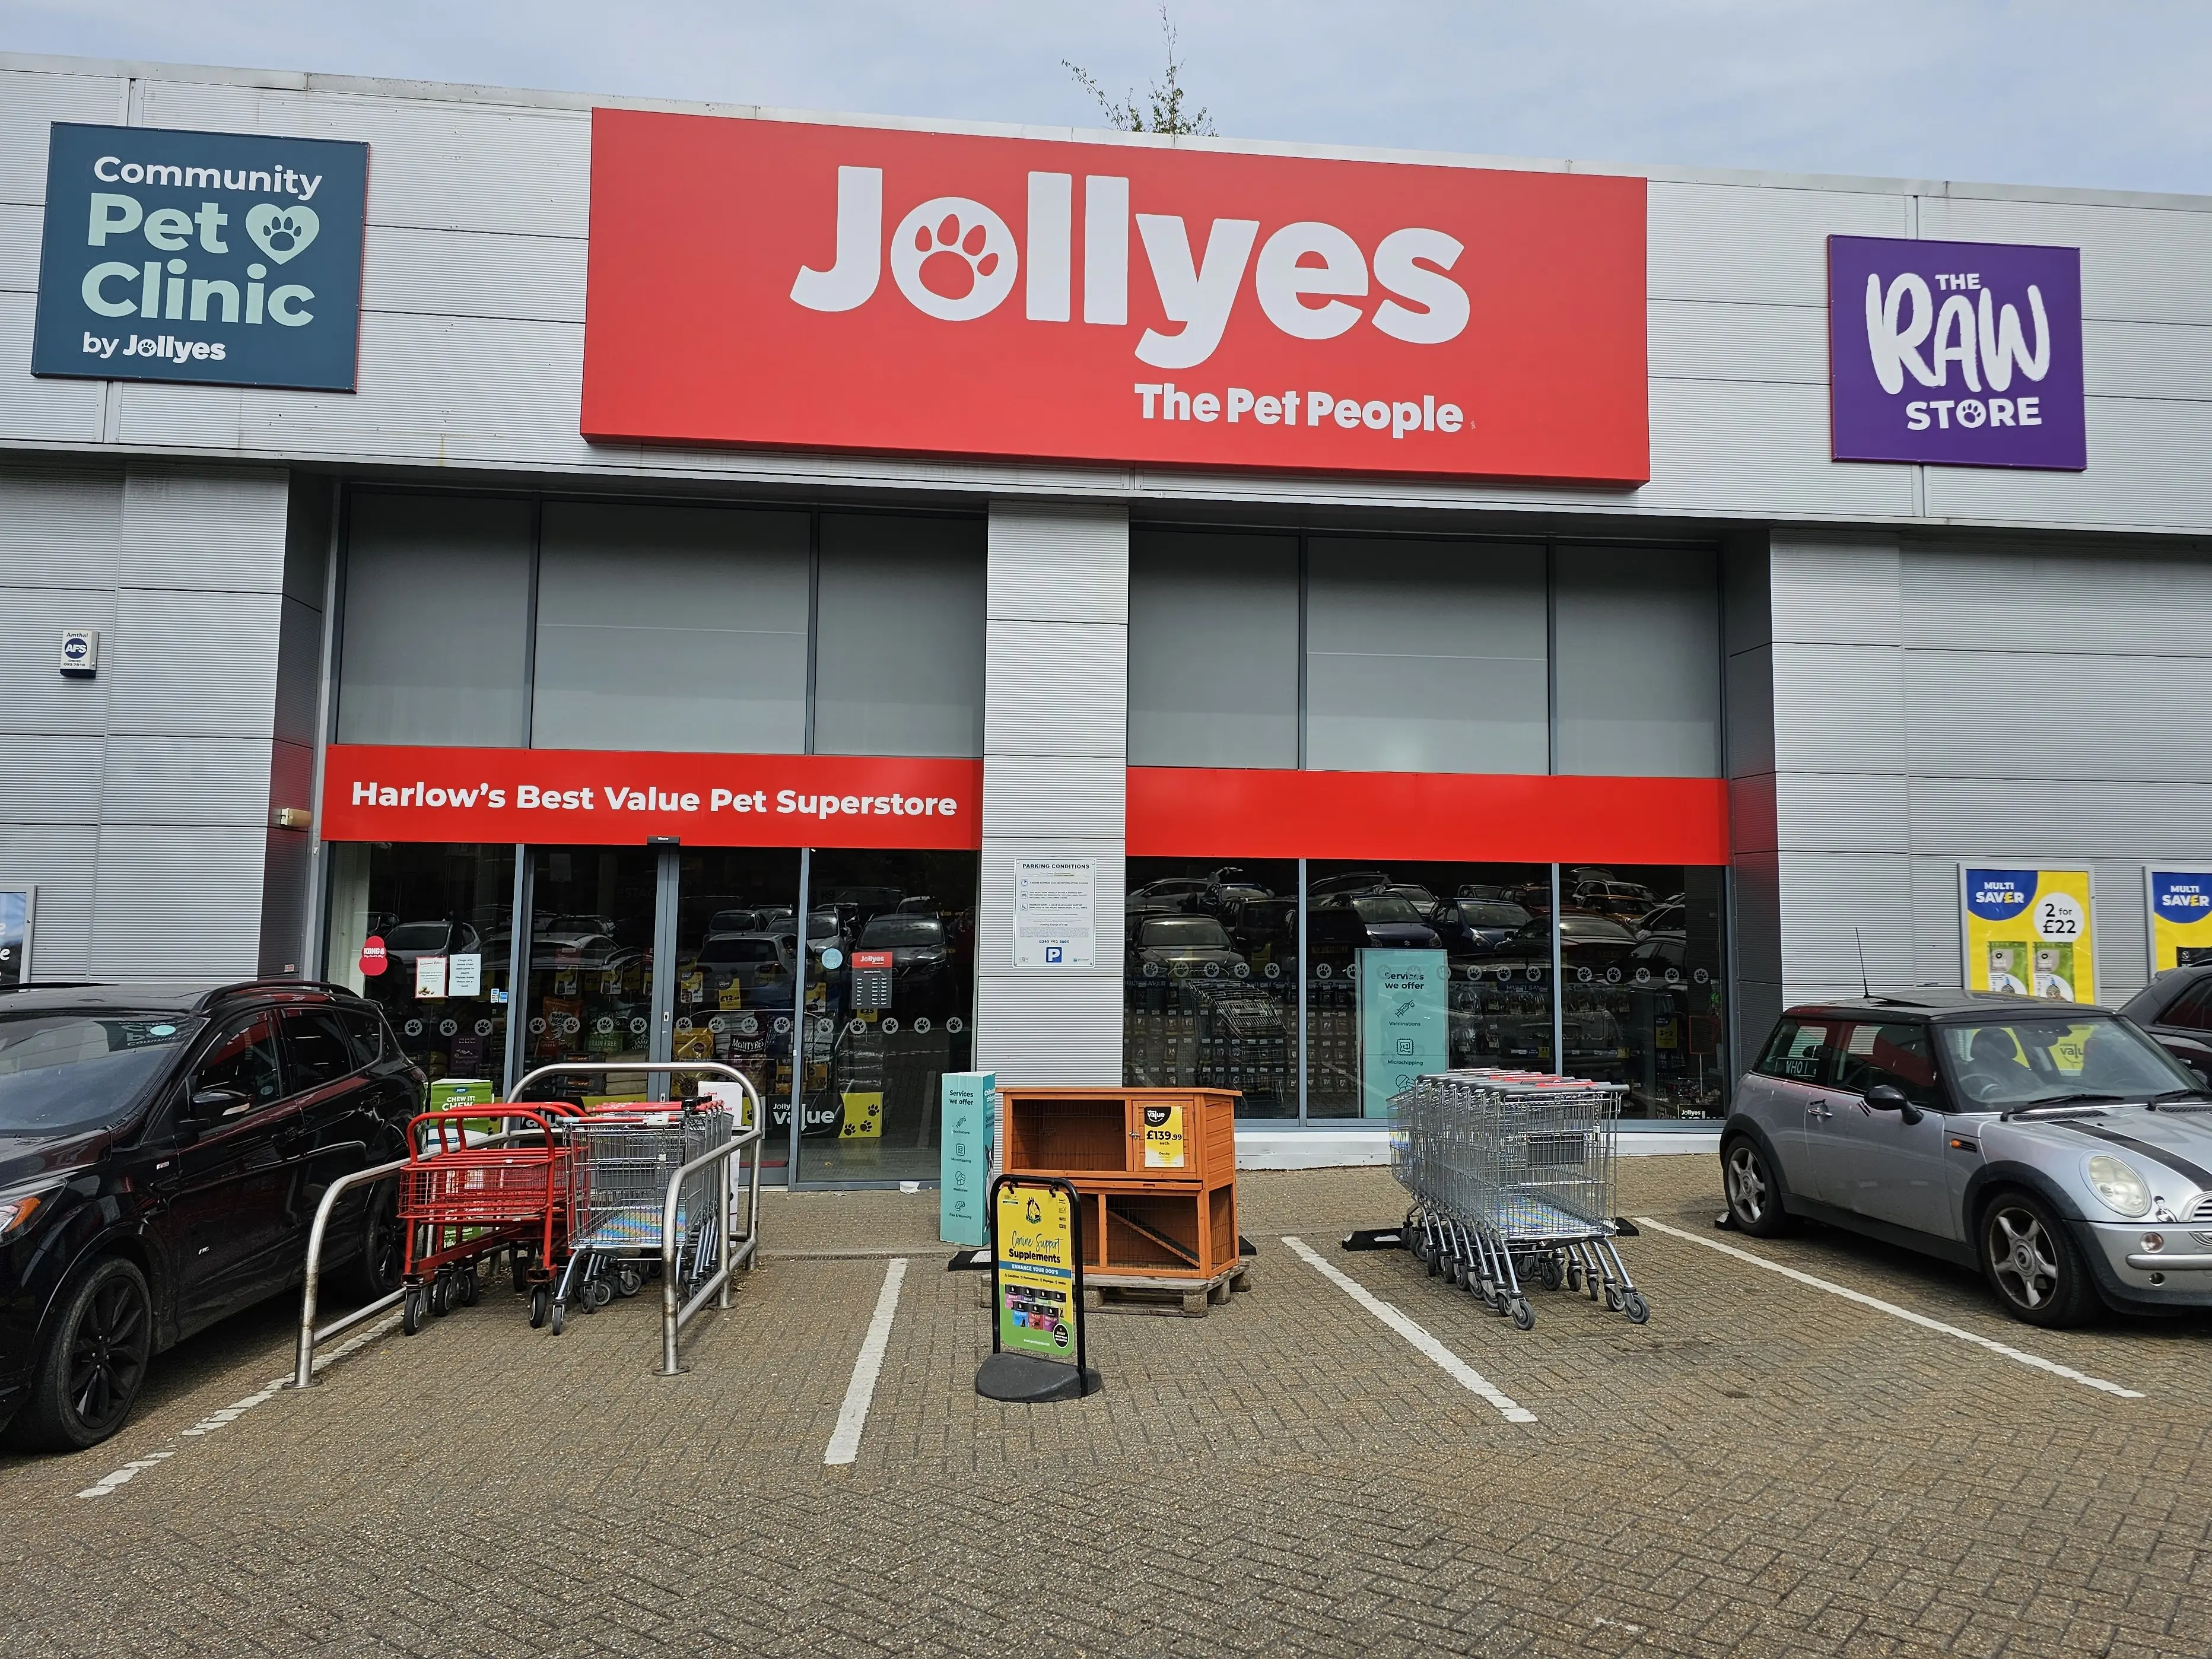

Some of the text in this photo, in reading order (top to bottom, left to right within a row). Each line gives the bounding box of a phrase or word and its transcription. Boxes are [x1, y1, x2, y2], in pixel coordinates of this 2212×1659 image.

[94, 156, 322, 201] Community
[88, 193, 229, 253] Pet
[790, 166, 1470, 368] Jollyes
[82, 259, 315, 326] Clinic
[1936, 274, 1981, 291] THE
[82, 332, 225, 363] by Jollyes
[1865, 273, 2050, 395] RAW
[1134, 383, 1463, 438] The Pet People
[1906, 398, 2042, 430] STORE
[65, 644, 87, 653] AFS
[517, 785, 594, 809] Best
[604, 786, 700, 811] Value
[711, 789, 767, 812] Pet
[777, 790, 957, 819] Superstore
[1984, 882, 2014, 890] MULTI
[2045, 903, 2055, 917] 2
[2043, 920, 2076, 934] £22
[1147, 1110, 1165, 1120] value
[1146, 1130, 1182, 1140] £139.99
[1009, 1248, 1061, 1263] Supplements
[1012, 1230, 1063, 1254] Canine Support
